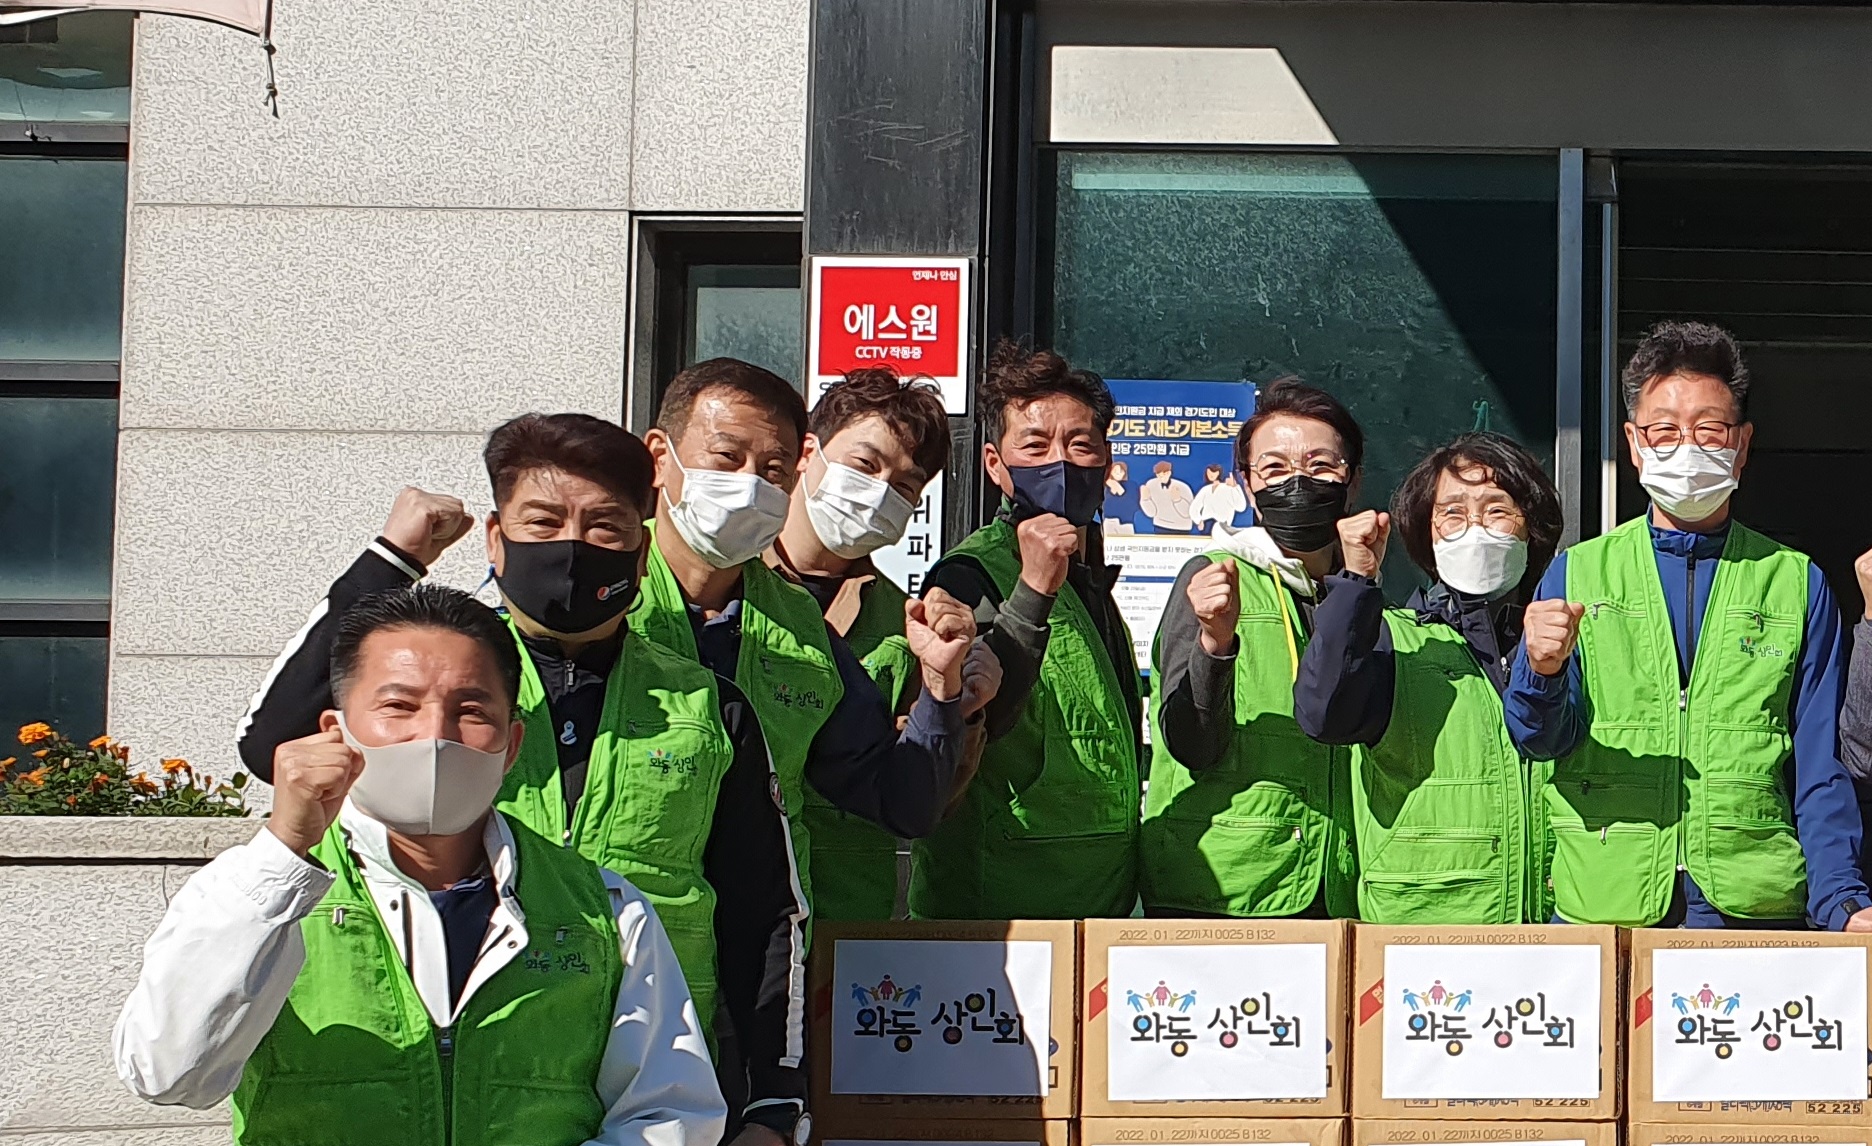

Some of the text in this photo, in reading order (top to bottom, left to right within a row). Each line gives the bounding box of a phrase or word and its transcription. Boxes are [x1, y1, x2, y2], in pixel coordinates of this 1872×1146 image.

[940, 270, 957, 281] 안심
[843, 304, 937, 341] 에스원
[855, 346, 922, 359] CCTV 작동중
[1133, 443, 1166, 456] 25만원
[1169, 443, 1190, 456] 지급
[854, 988, 1024, 1052] 와동 상인회
[1131, 993, 1299, 1057] 와동 상인회
[1406, 993, 1573, 1055] 와동 상인회
[1676, 996, 1842, 1059] 와동 상인회
